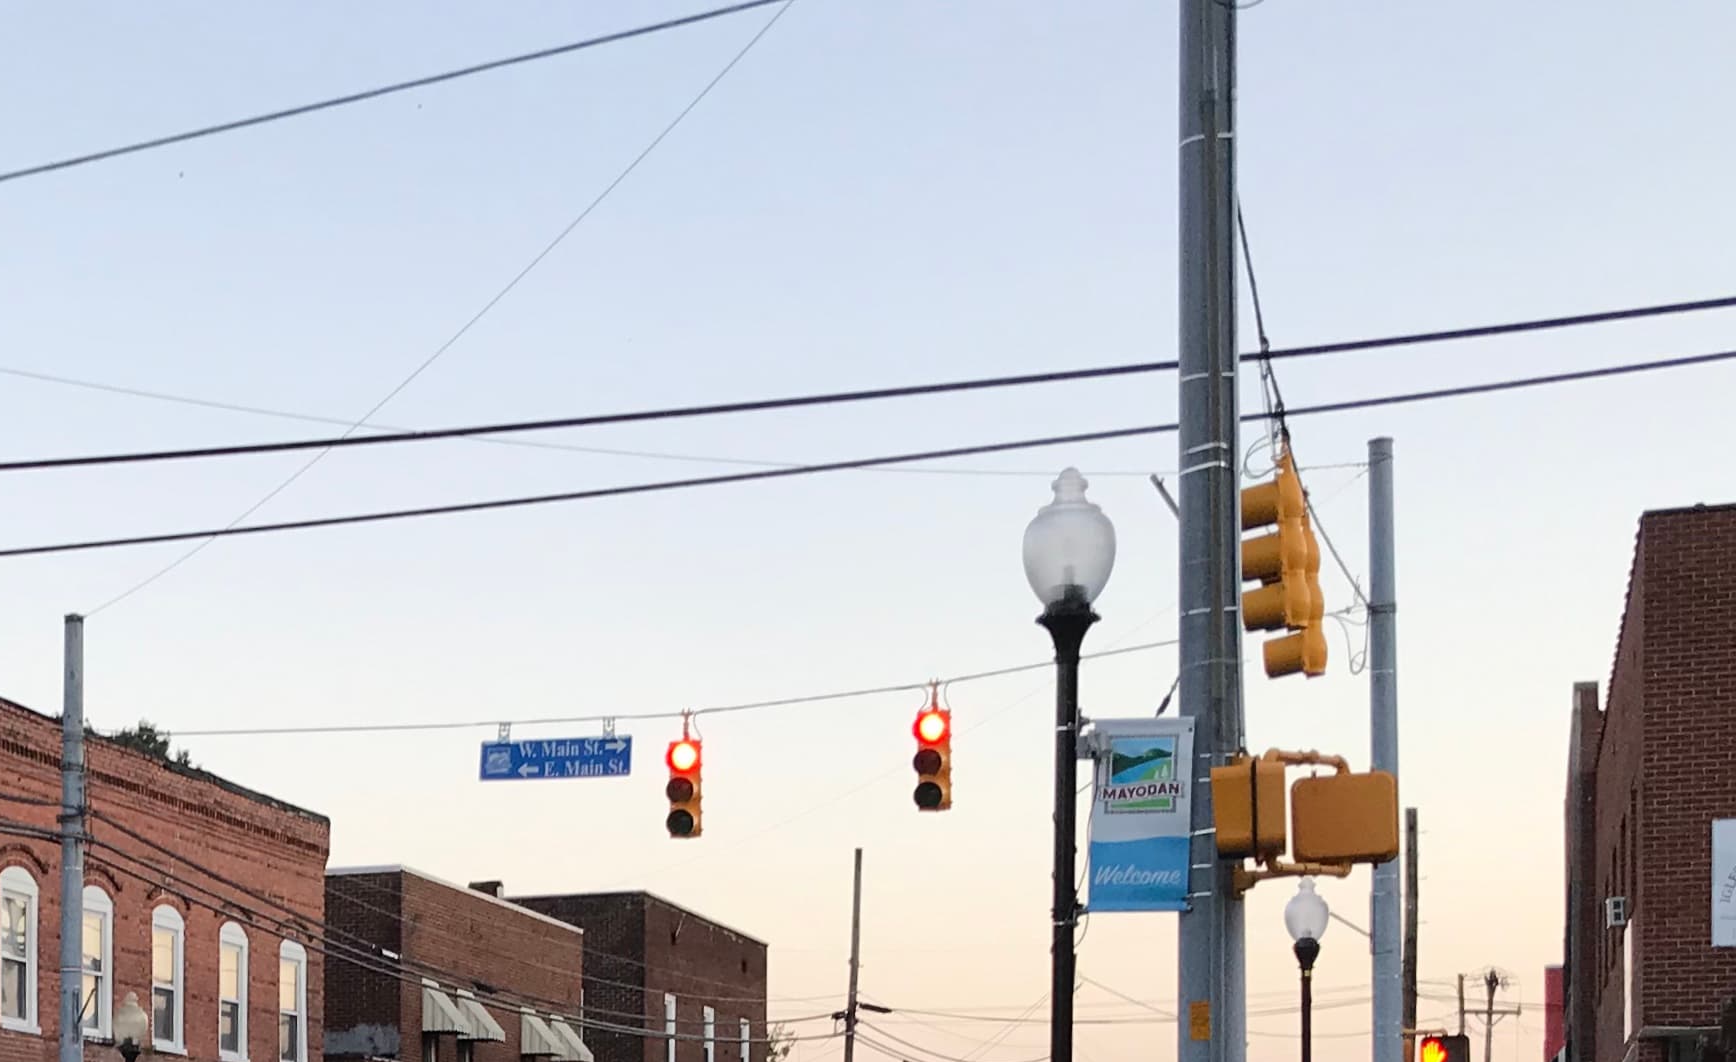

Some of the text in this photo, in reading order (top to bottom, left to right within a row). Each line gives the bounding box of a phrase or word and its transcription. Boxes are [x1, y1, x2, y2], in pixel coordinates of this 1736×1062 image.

[518, 740, 604, 758] W. Main St.
[543, 759, 628, 777] E. Main St.
[1101, 782, 1180, 801] MAYODAN
[1094, 864, 1182, 886] Welcome
[1720, 865, 1736, 903] IGLE
